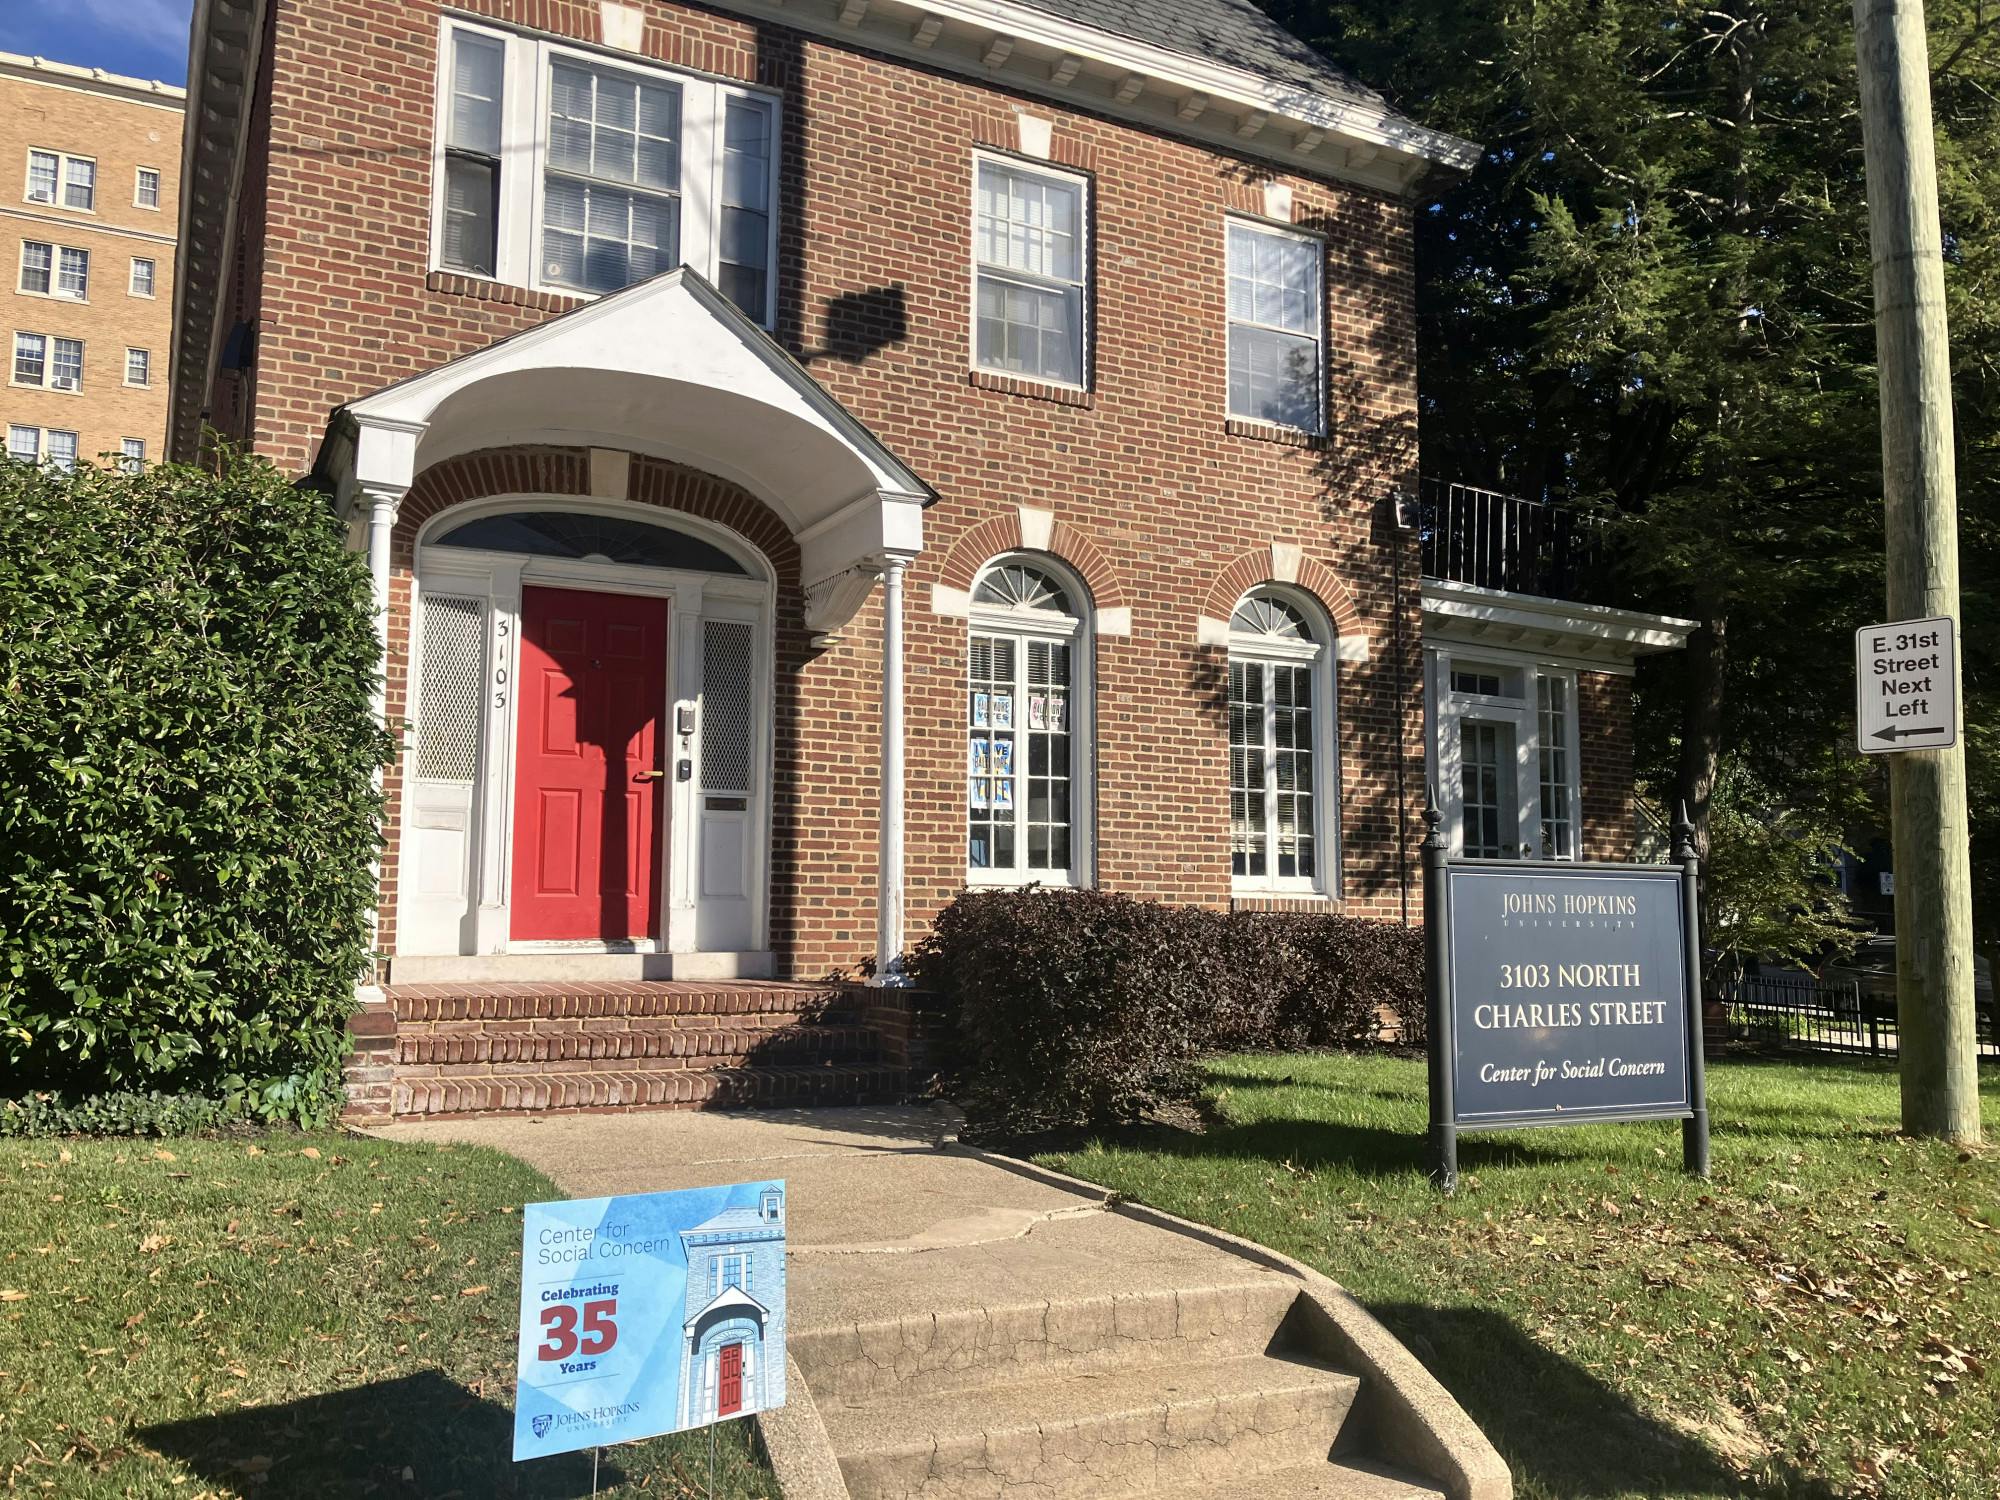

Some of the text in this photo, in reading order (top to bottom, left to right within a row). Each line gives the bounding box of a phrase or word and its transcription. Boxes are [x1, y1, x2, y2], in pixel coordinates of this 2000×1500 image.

[1873, 631, 1939, 653] E. 31st
[494, 619, 509, 709] 3103
[1873, 654, 1939, 675] Street
[1882, 677, 1932, 696] Next
[1886, 699, 1929, 717] Left
[1501, 893, 1637, 918] JOHNS HOPKINS
[1504, 919, 1635, 929] UNIVERSITY
[1500, 963, 1641, 988] 3103 NORTH
[1474, 1001, 1667, 1029] CHARLES STREET
[1480, 1058, 1665, 1087] Center for Social Concern
[539, 1221, 630, 1245] Center for
[538, 1238, 670, 1265] Social Concern
[541, 1282, 619, 1302] Celebrating
[537, 1298, 618, 1362] 35
[559, 1360, 597, 1375] Years
[554, 1401, 640, 1429] JOHNS HOPKINS
[567, 1416, 628, 1433] UNIVERSITY
